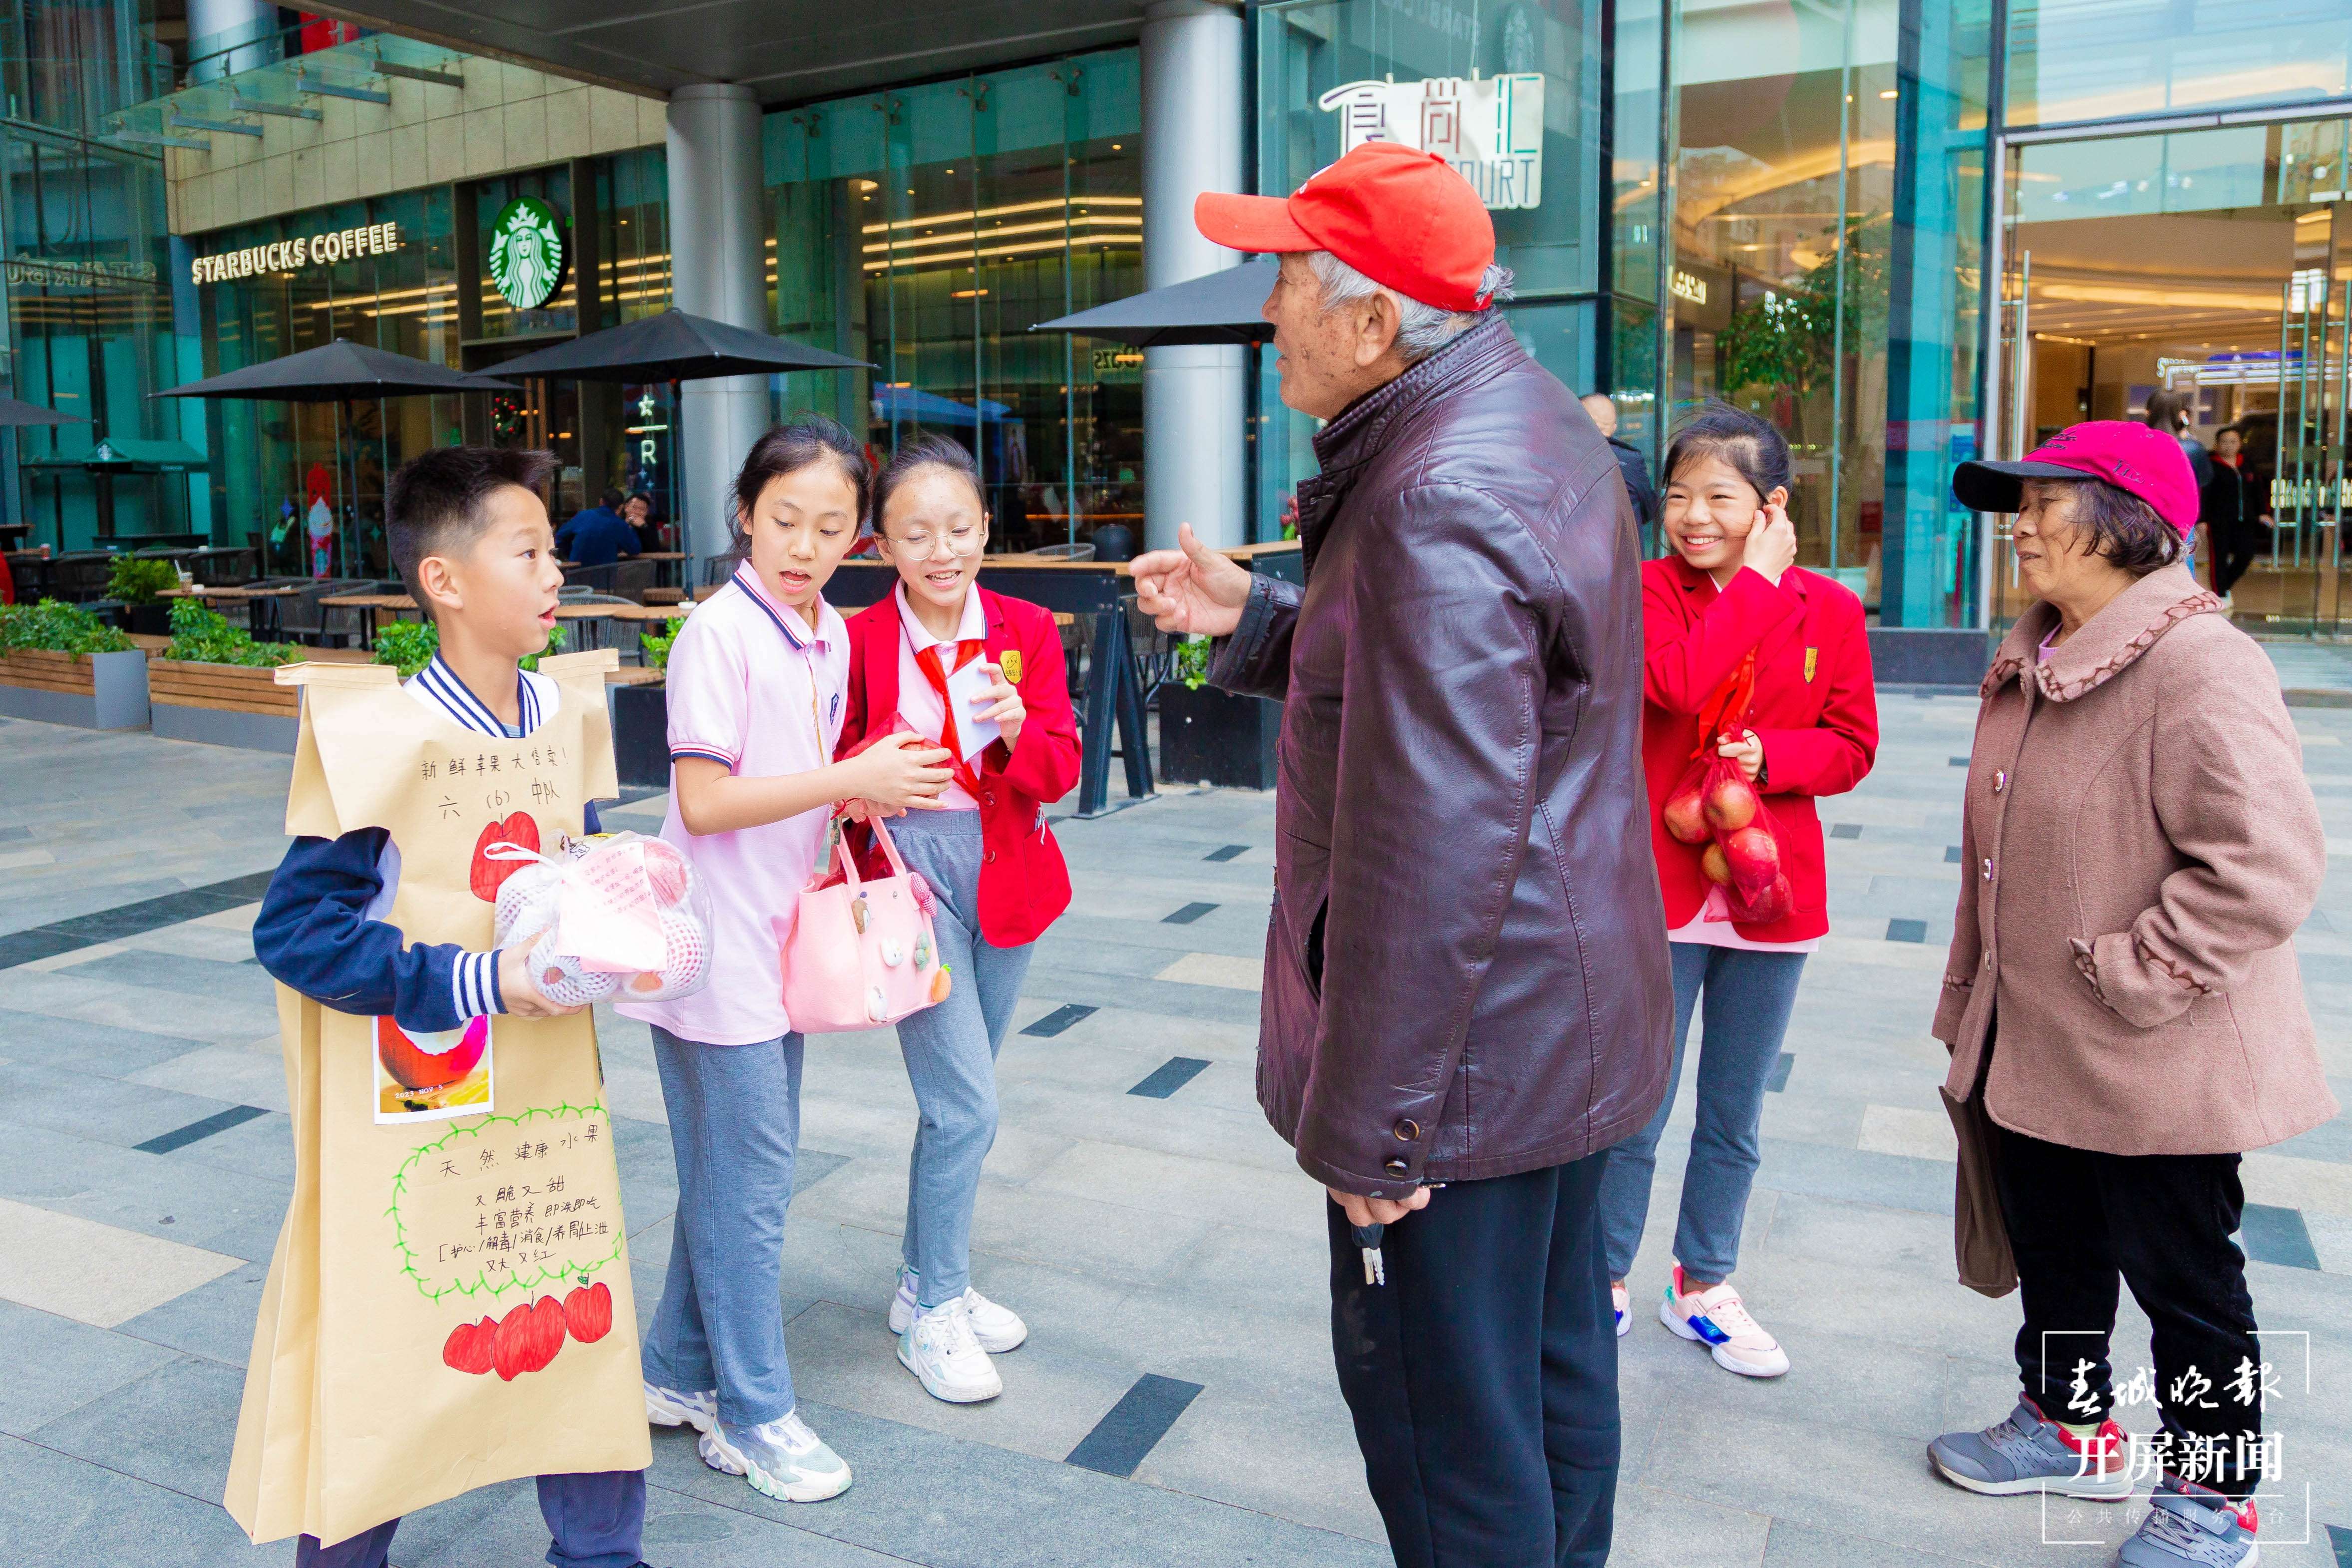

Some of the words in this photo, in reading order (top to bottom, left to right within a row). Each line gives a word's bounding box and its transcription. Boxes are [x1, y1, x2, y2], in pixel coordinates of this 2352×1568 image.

[1444, 159, 1534, 204] URT
[191, 237, 306, 285] STARBUCKS
[310, 221, 398, 265] COFFEE
[641, 439, 657, 465] R
[418, 1086, 434, 1095] NOV
